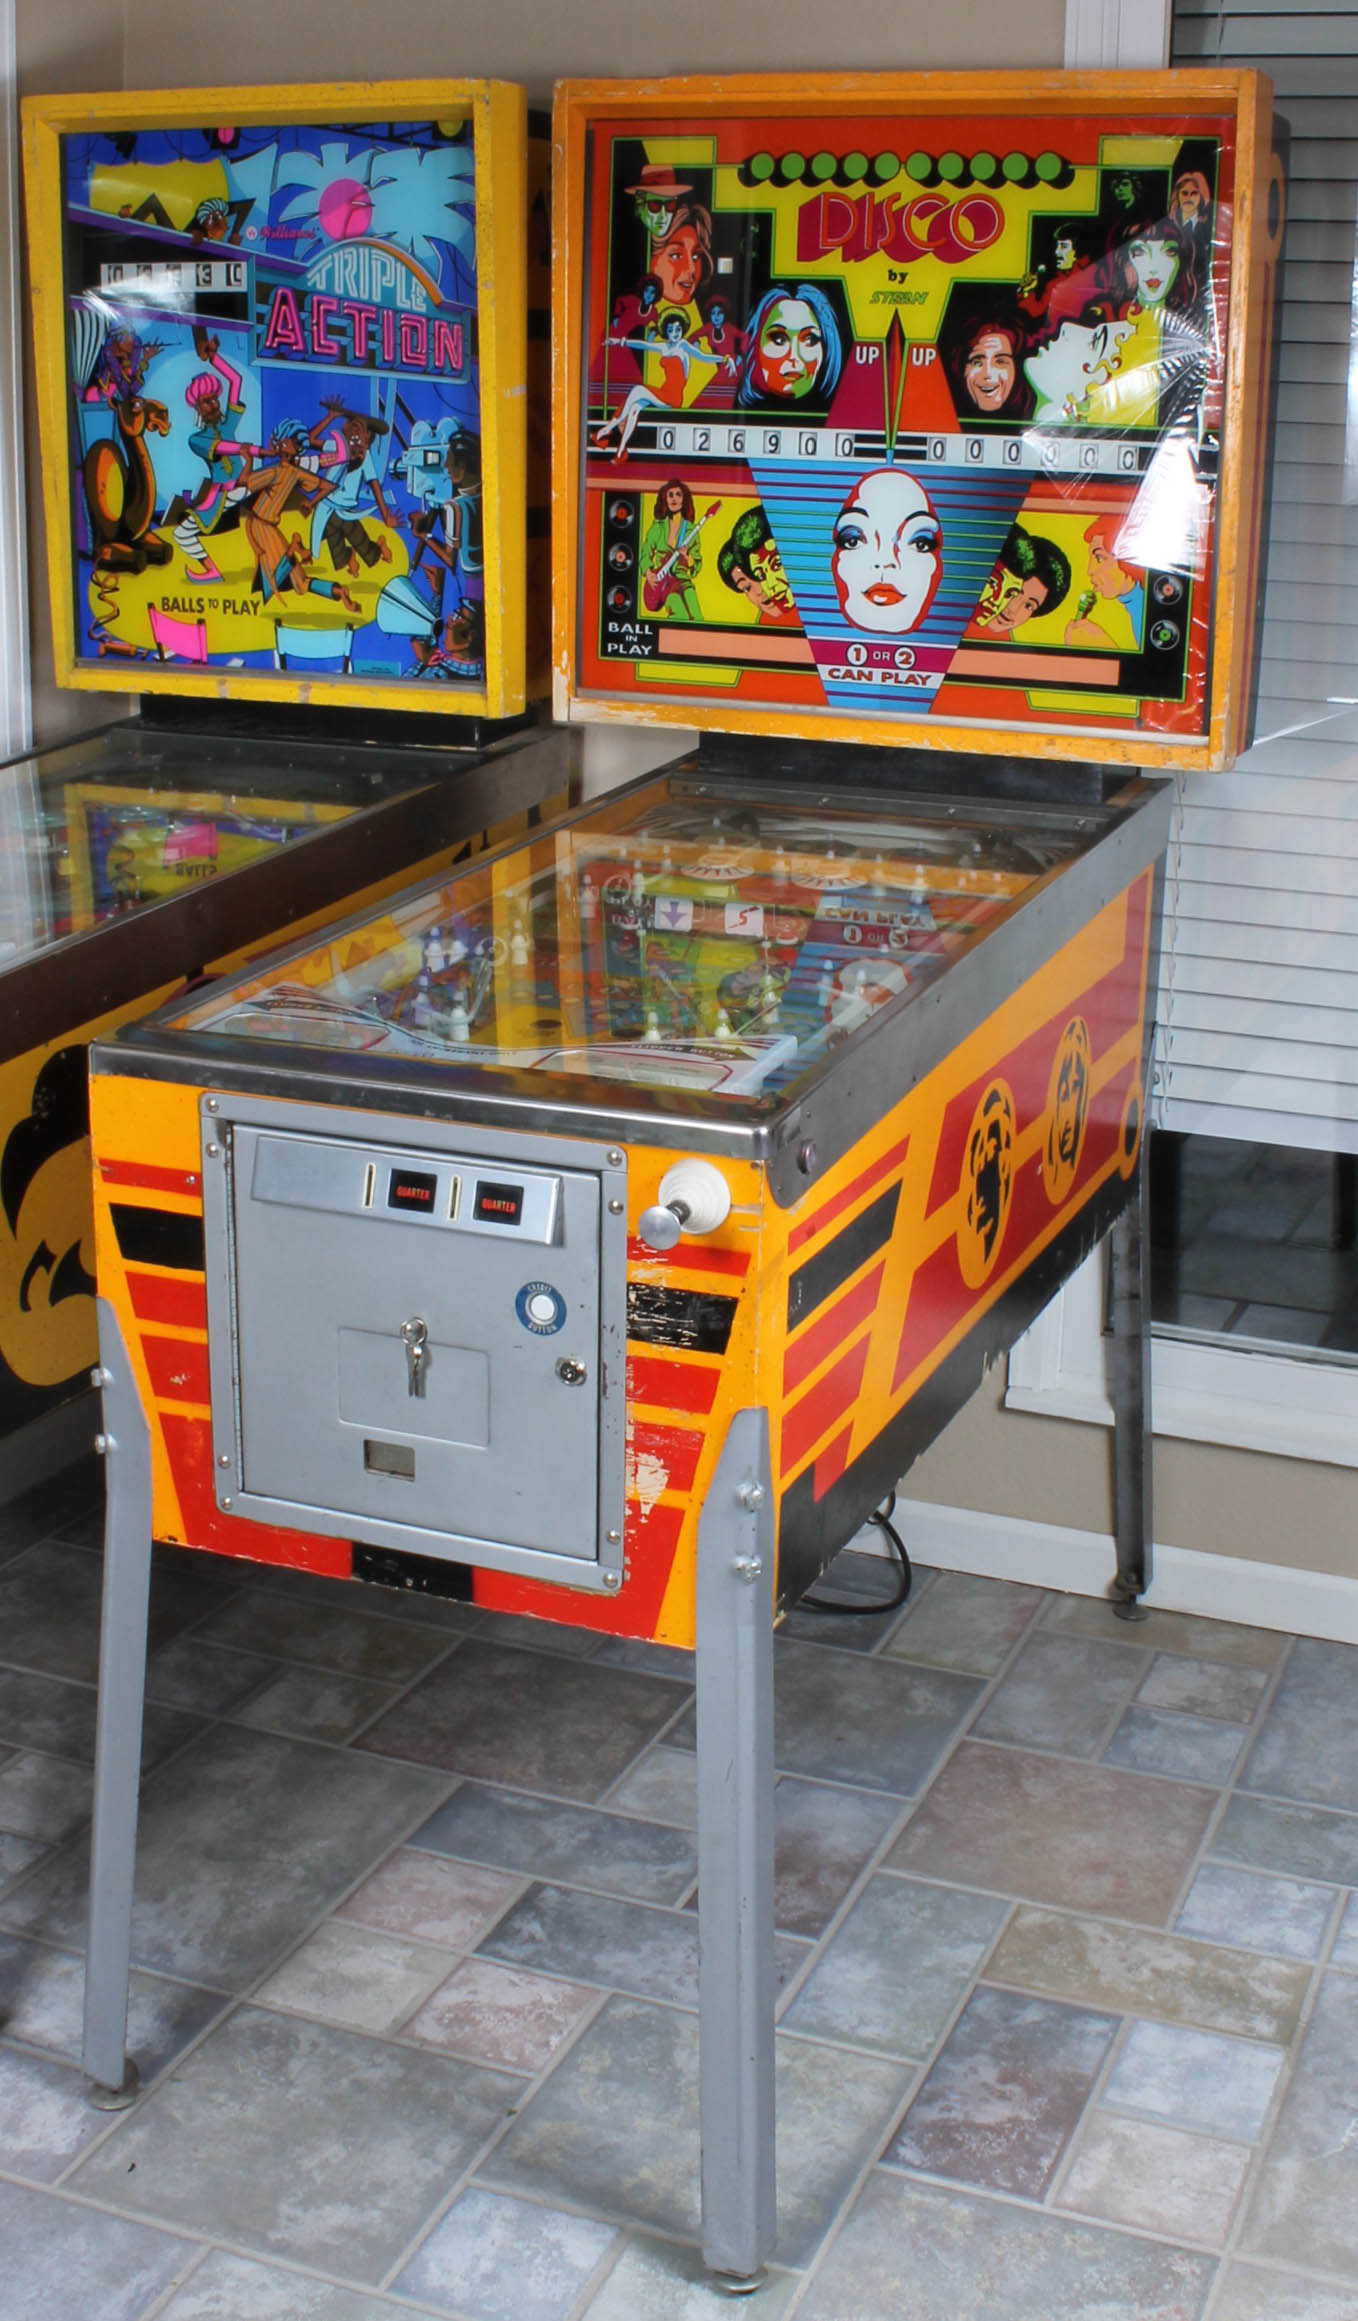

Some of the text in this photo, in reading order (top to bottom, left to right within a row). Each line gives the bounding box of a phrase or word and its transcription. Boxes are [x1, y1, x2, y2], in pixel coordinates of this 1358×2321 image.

[808, 192, 1005, 257] DISCO
[306, 246, 428, 313] TRIPLE
[887, 269, 908, 285] by
[869, 290, 929, 305] STERN
[264, 286, 464, 372] ACTION
[855, 345, 880, 365] UP
[911, 347, 937, 366] UP
[161, 597, 260, 616] BALLS TO PLAY
[607, 622, 653, 635] BALL
[625, 634, 638, 642] IN
[607, 643, 652, 656] PLAY
[872, 650, 891, 661] OR
[897, 650, 912, 665] 2
[828, 667, 931, 686] CAN PLAY
[396, 1184, 430, 1201] QUARTER
[481, 1197, 516, 1214] QUARTER
